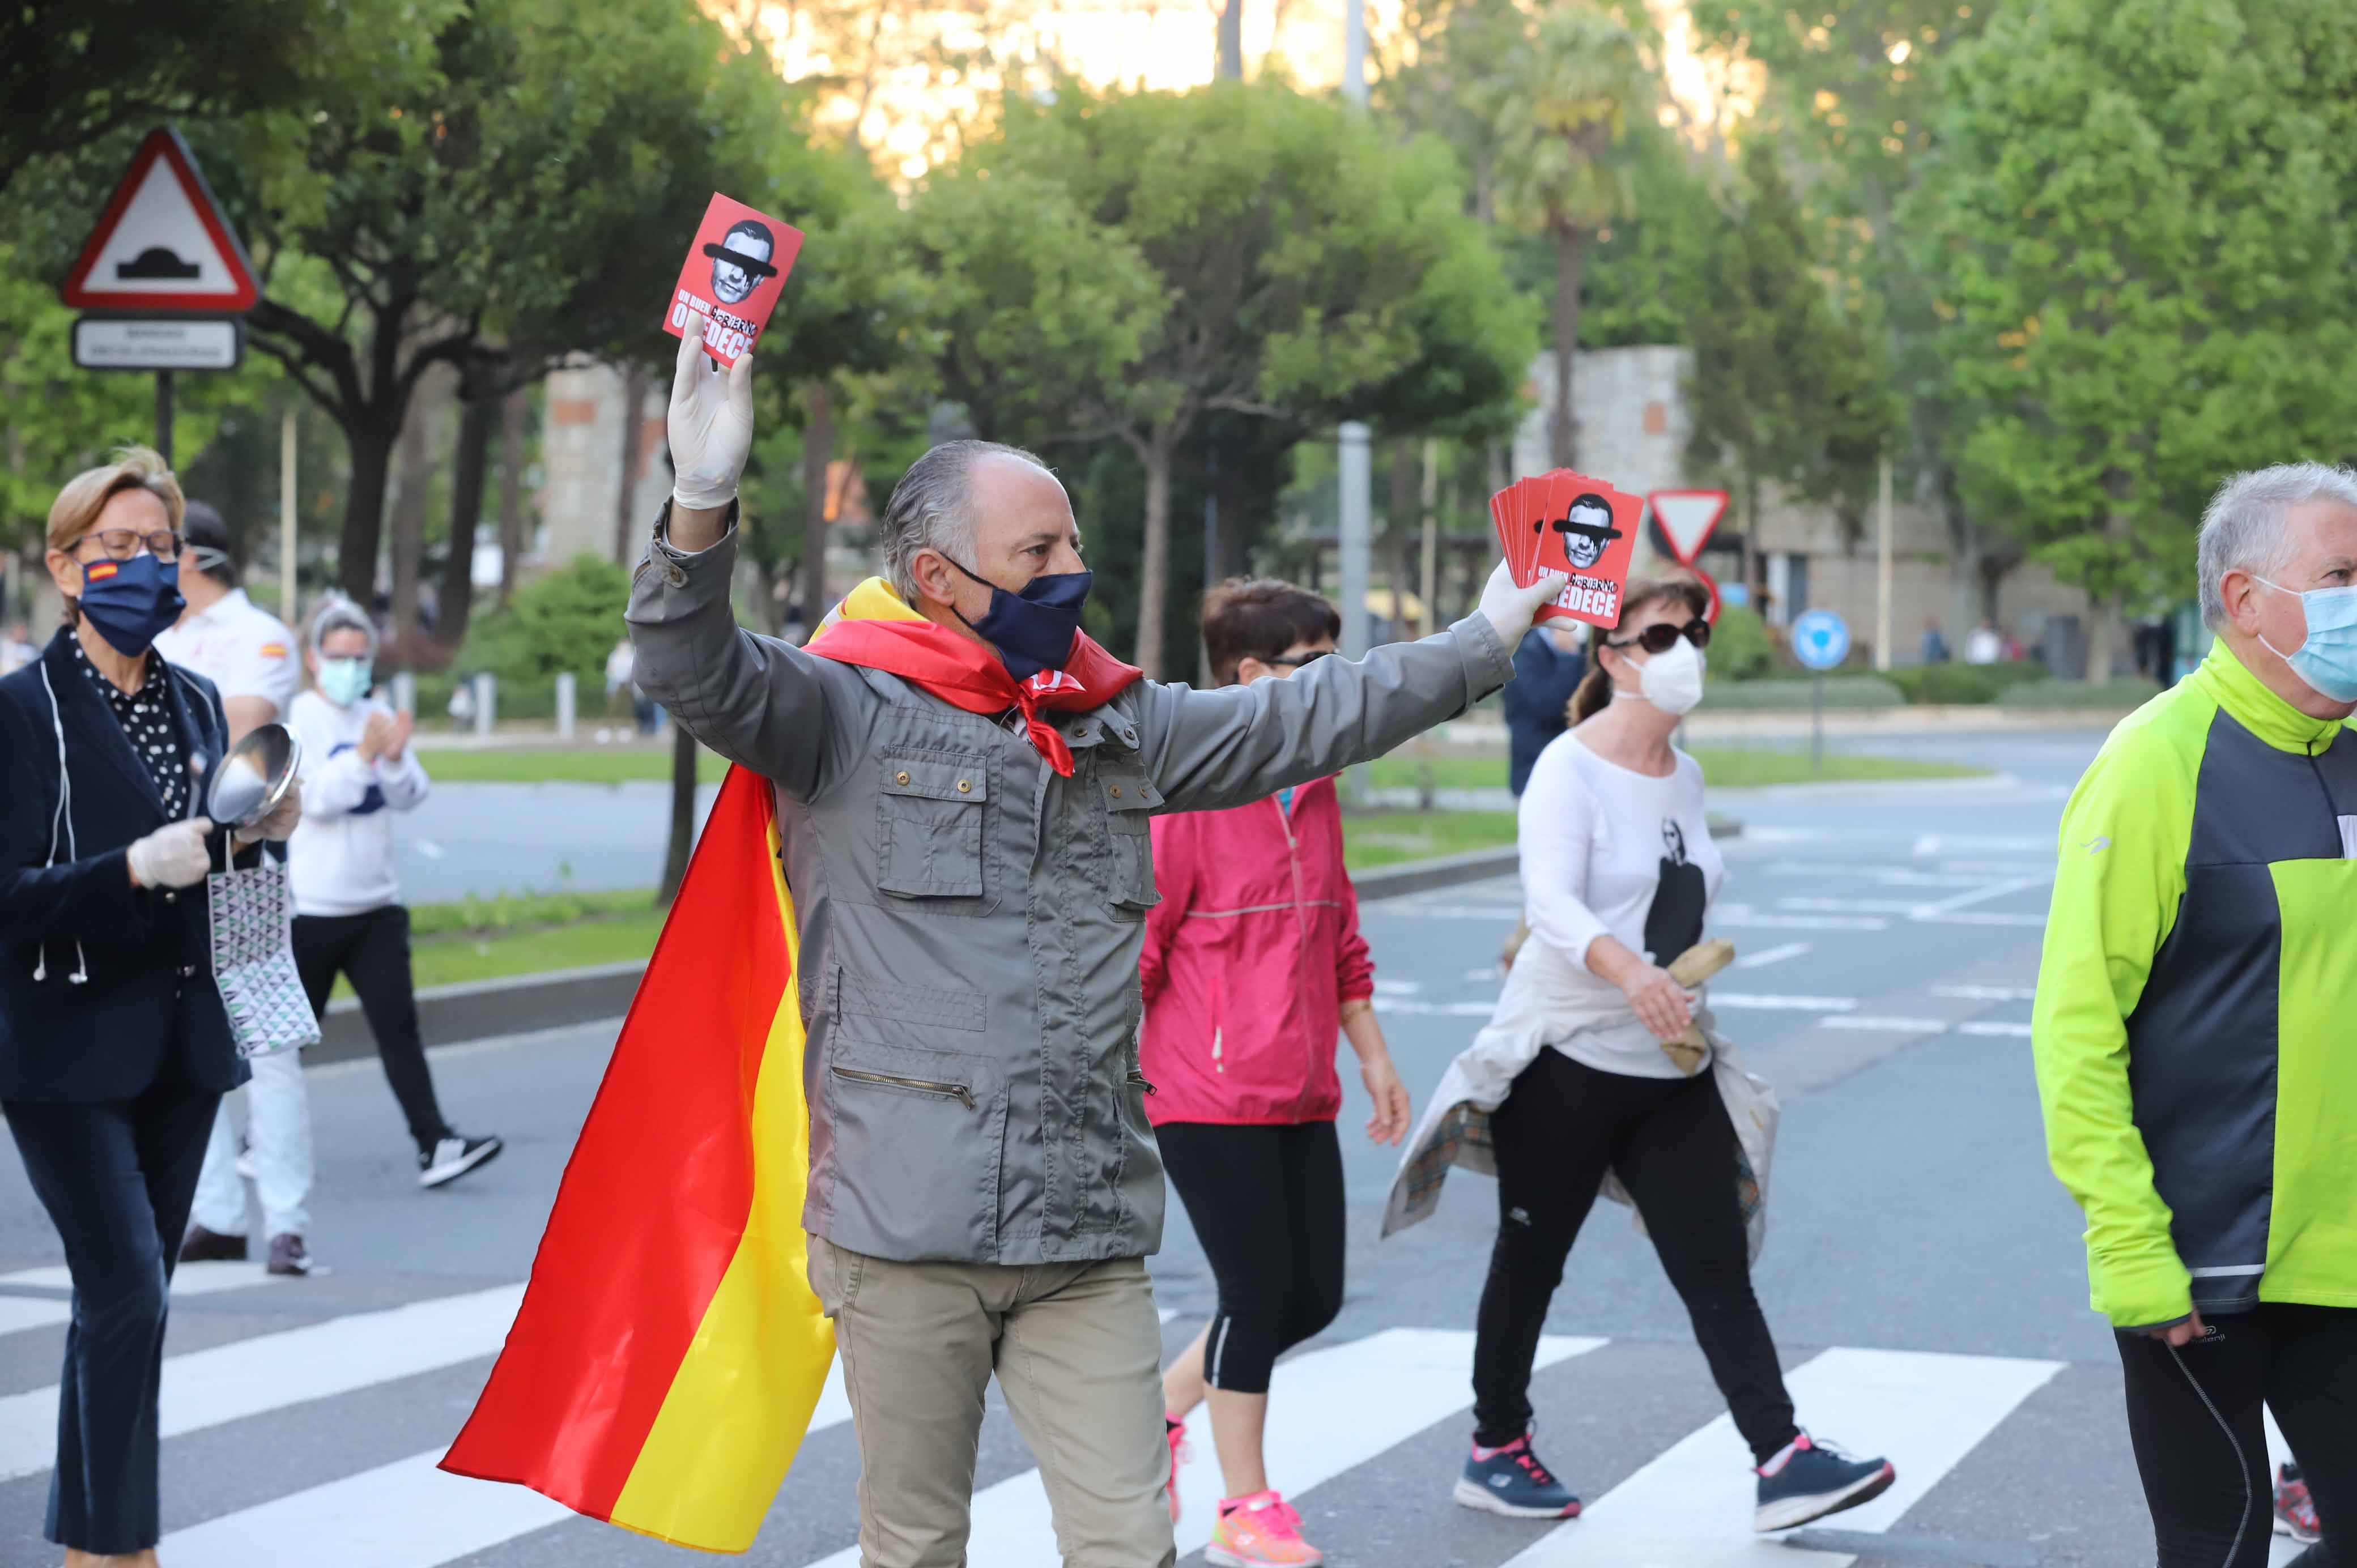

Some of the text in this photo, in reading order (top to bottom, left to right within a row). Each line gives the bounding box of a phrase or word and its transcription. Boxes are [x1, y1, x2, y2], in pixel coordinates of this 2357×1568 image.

[678, 289, 691, 304] UN
[689, 295, 711, 314] BUEN
[672, 303, 753, 359] OEDECE
[1538, 565, 1549, 578] UN
